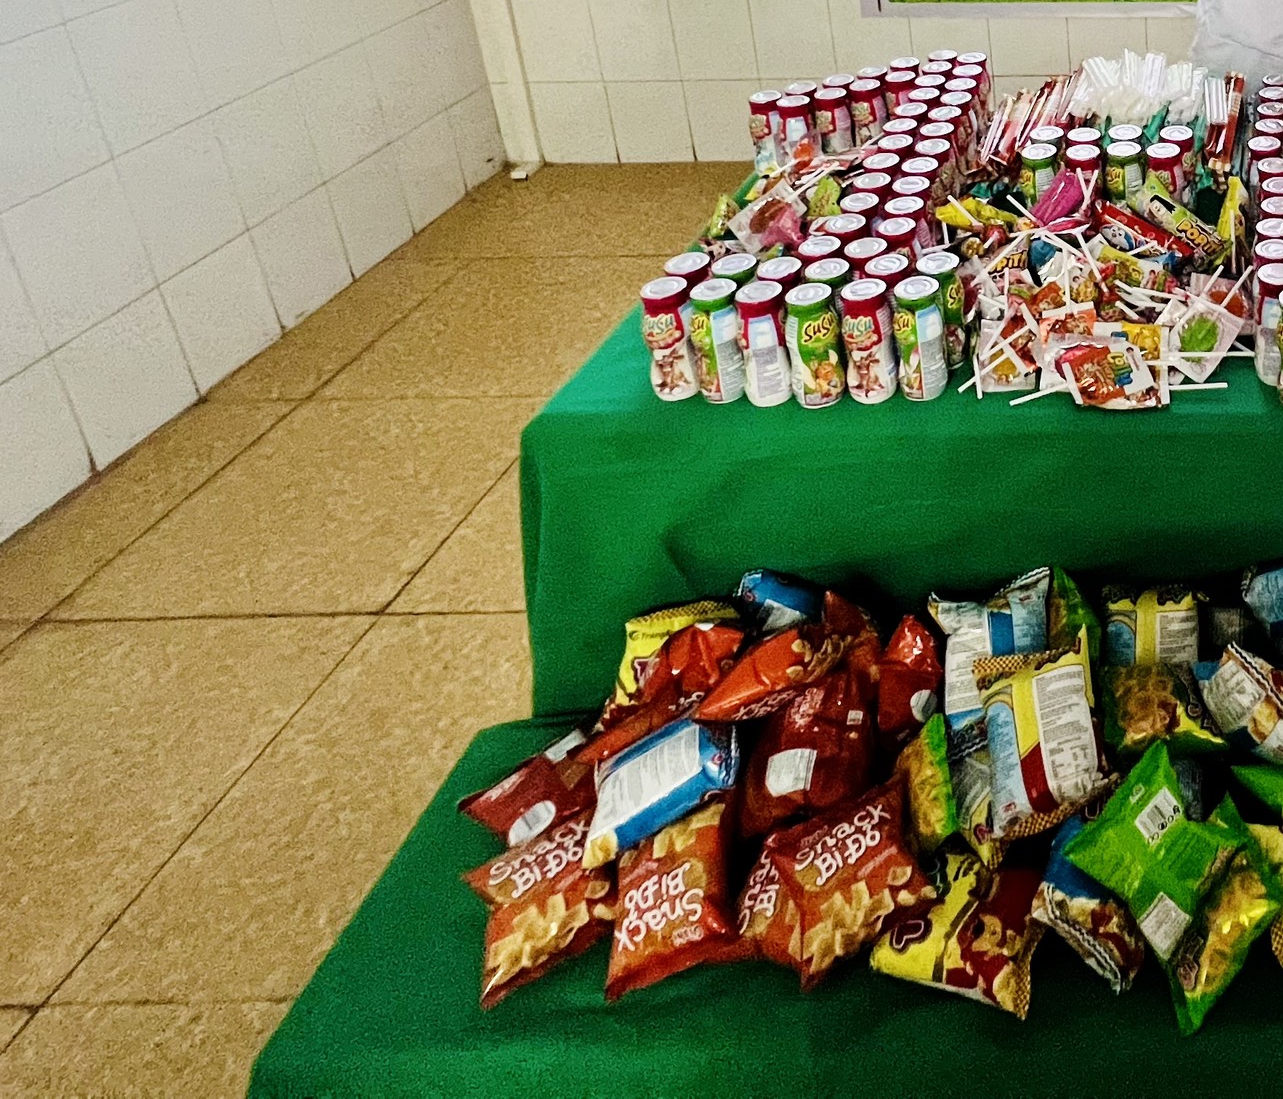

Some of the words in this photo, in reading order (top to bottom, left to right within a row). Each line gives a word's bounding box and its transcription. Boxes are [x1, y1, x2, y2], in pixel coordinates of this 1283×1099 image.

[489, 820, 590, 886] Snack
[794, 804, 892, 871] Snack
[614, 888, 705, 952] Snack
